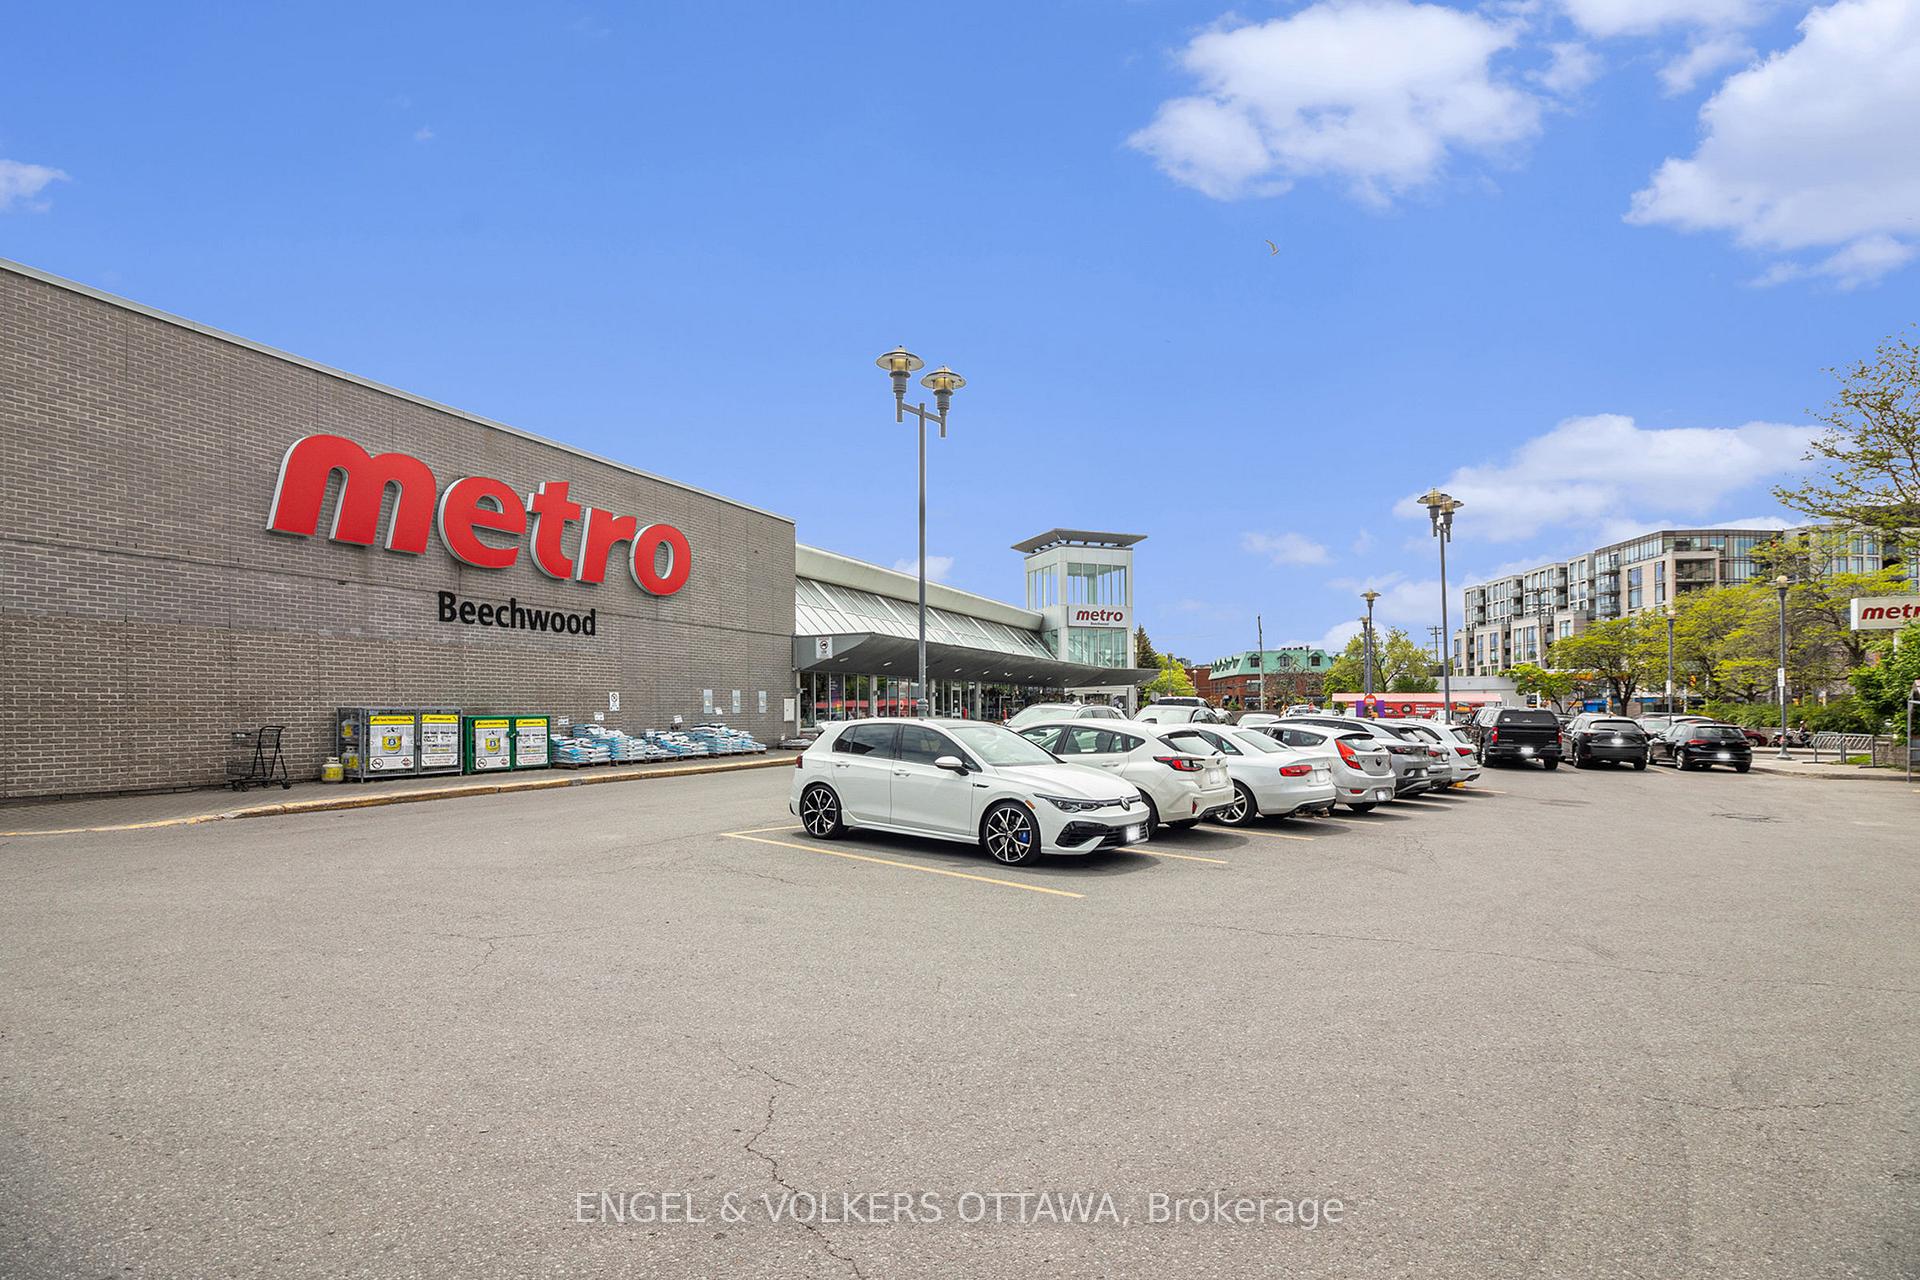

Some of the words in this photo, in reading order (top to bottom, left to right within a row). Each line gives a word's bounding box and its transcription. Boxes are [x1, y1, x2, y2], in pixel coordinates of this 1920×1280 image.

[266, 434, 691, 595] metro
[438, 591, 596, 636] Beechwood
[1076, 609, 1123, 622] metro
